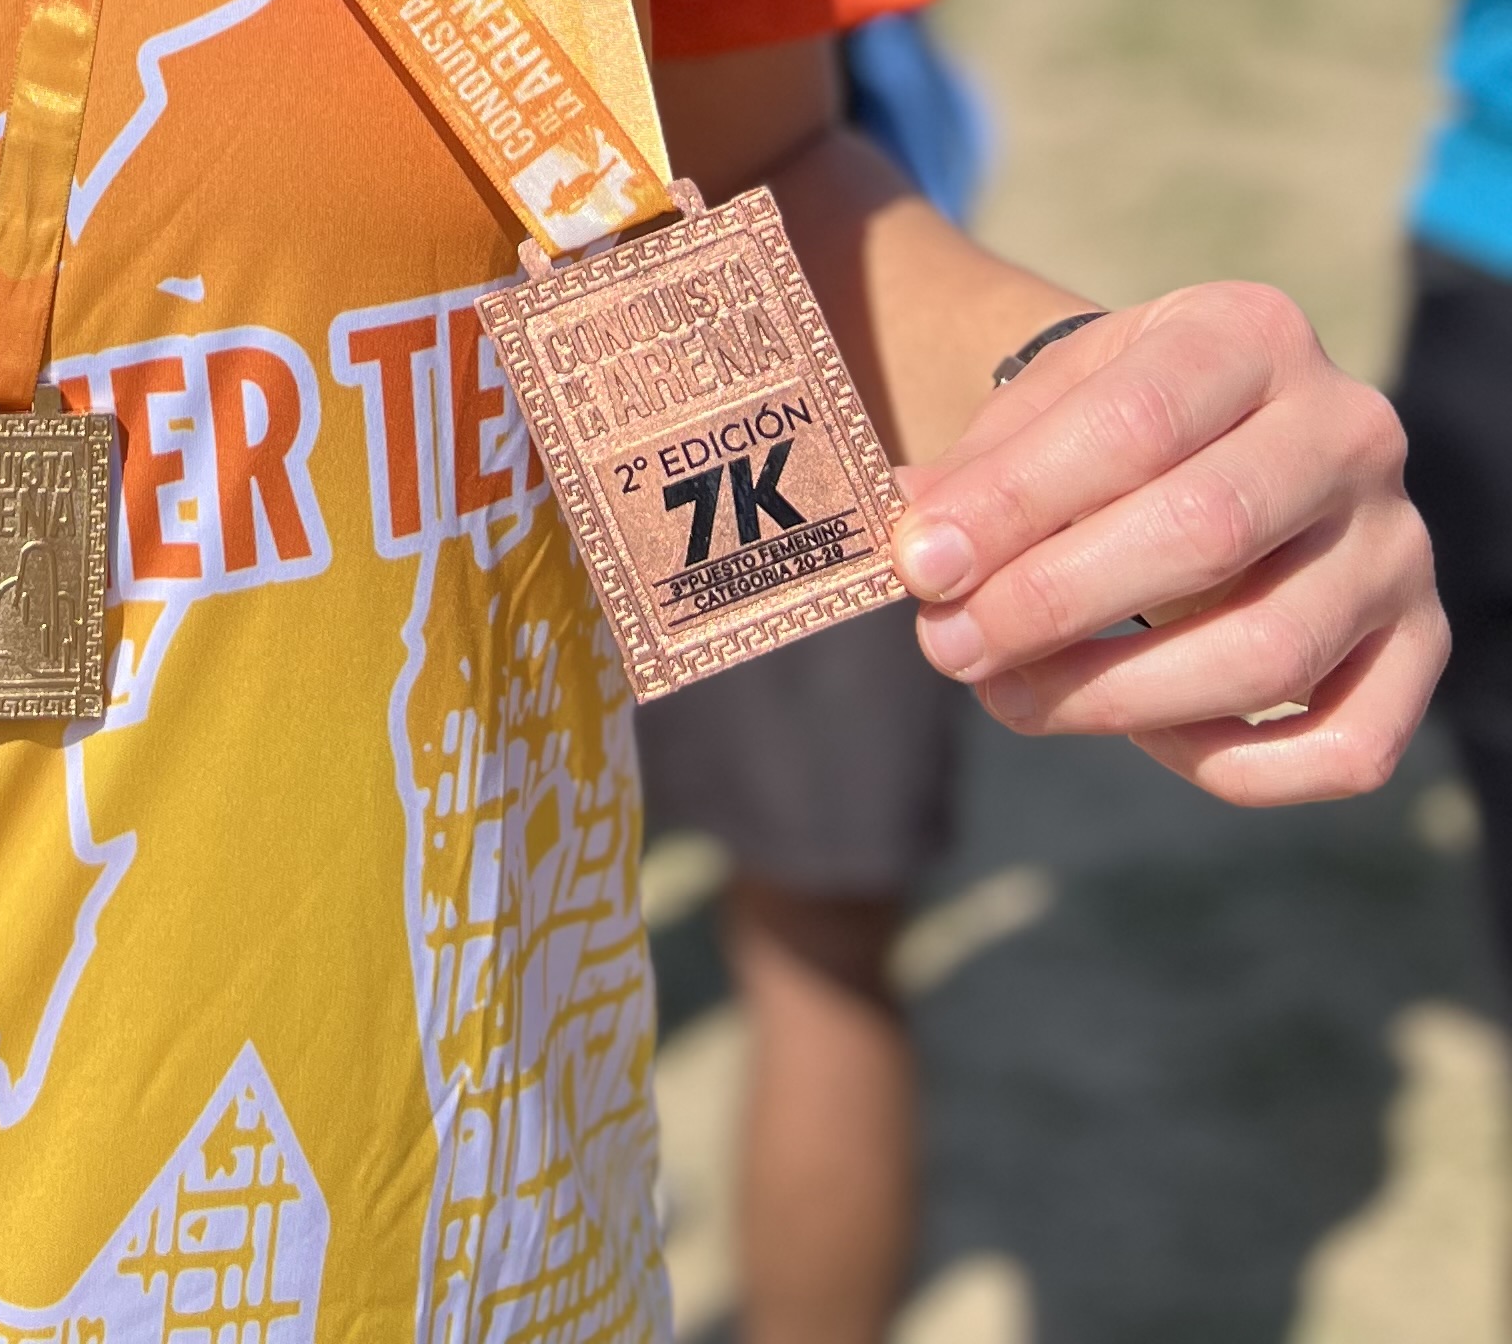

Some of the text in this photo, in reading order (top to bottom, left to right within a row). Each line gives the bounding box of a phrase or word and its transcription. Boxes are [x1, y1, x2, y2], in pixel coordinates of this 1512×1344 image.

[545, 254, 764, 374] CONQUISTA
[561, 369, 595, 409] DE
[603, 301, 792, 426] ARENA
[574, 402, 610, 441] LA
[658, 397, 812, 477] EDICIÓN
[663, 438, 807, 567] 7K
[759, 519, 848, 564] FEMENINO
